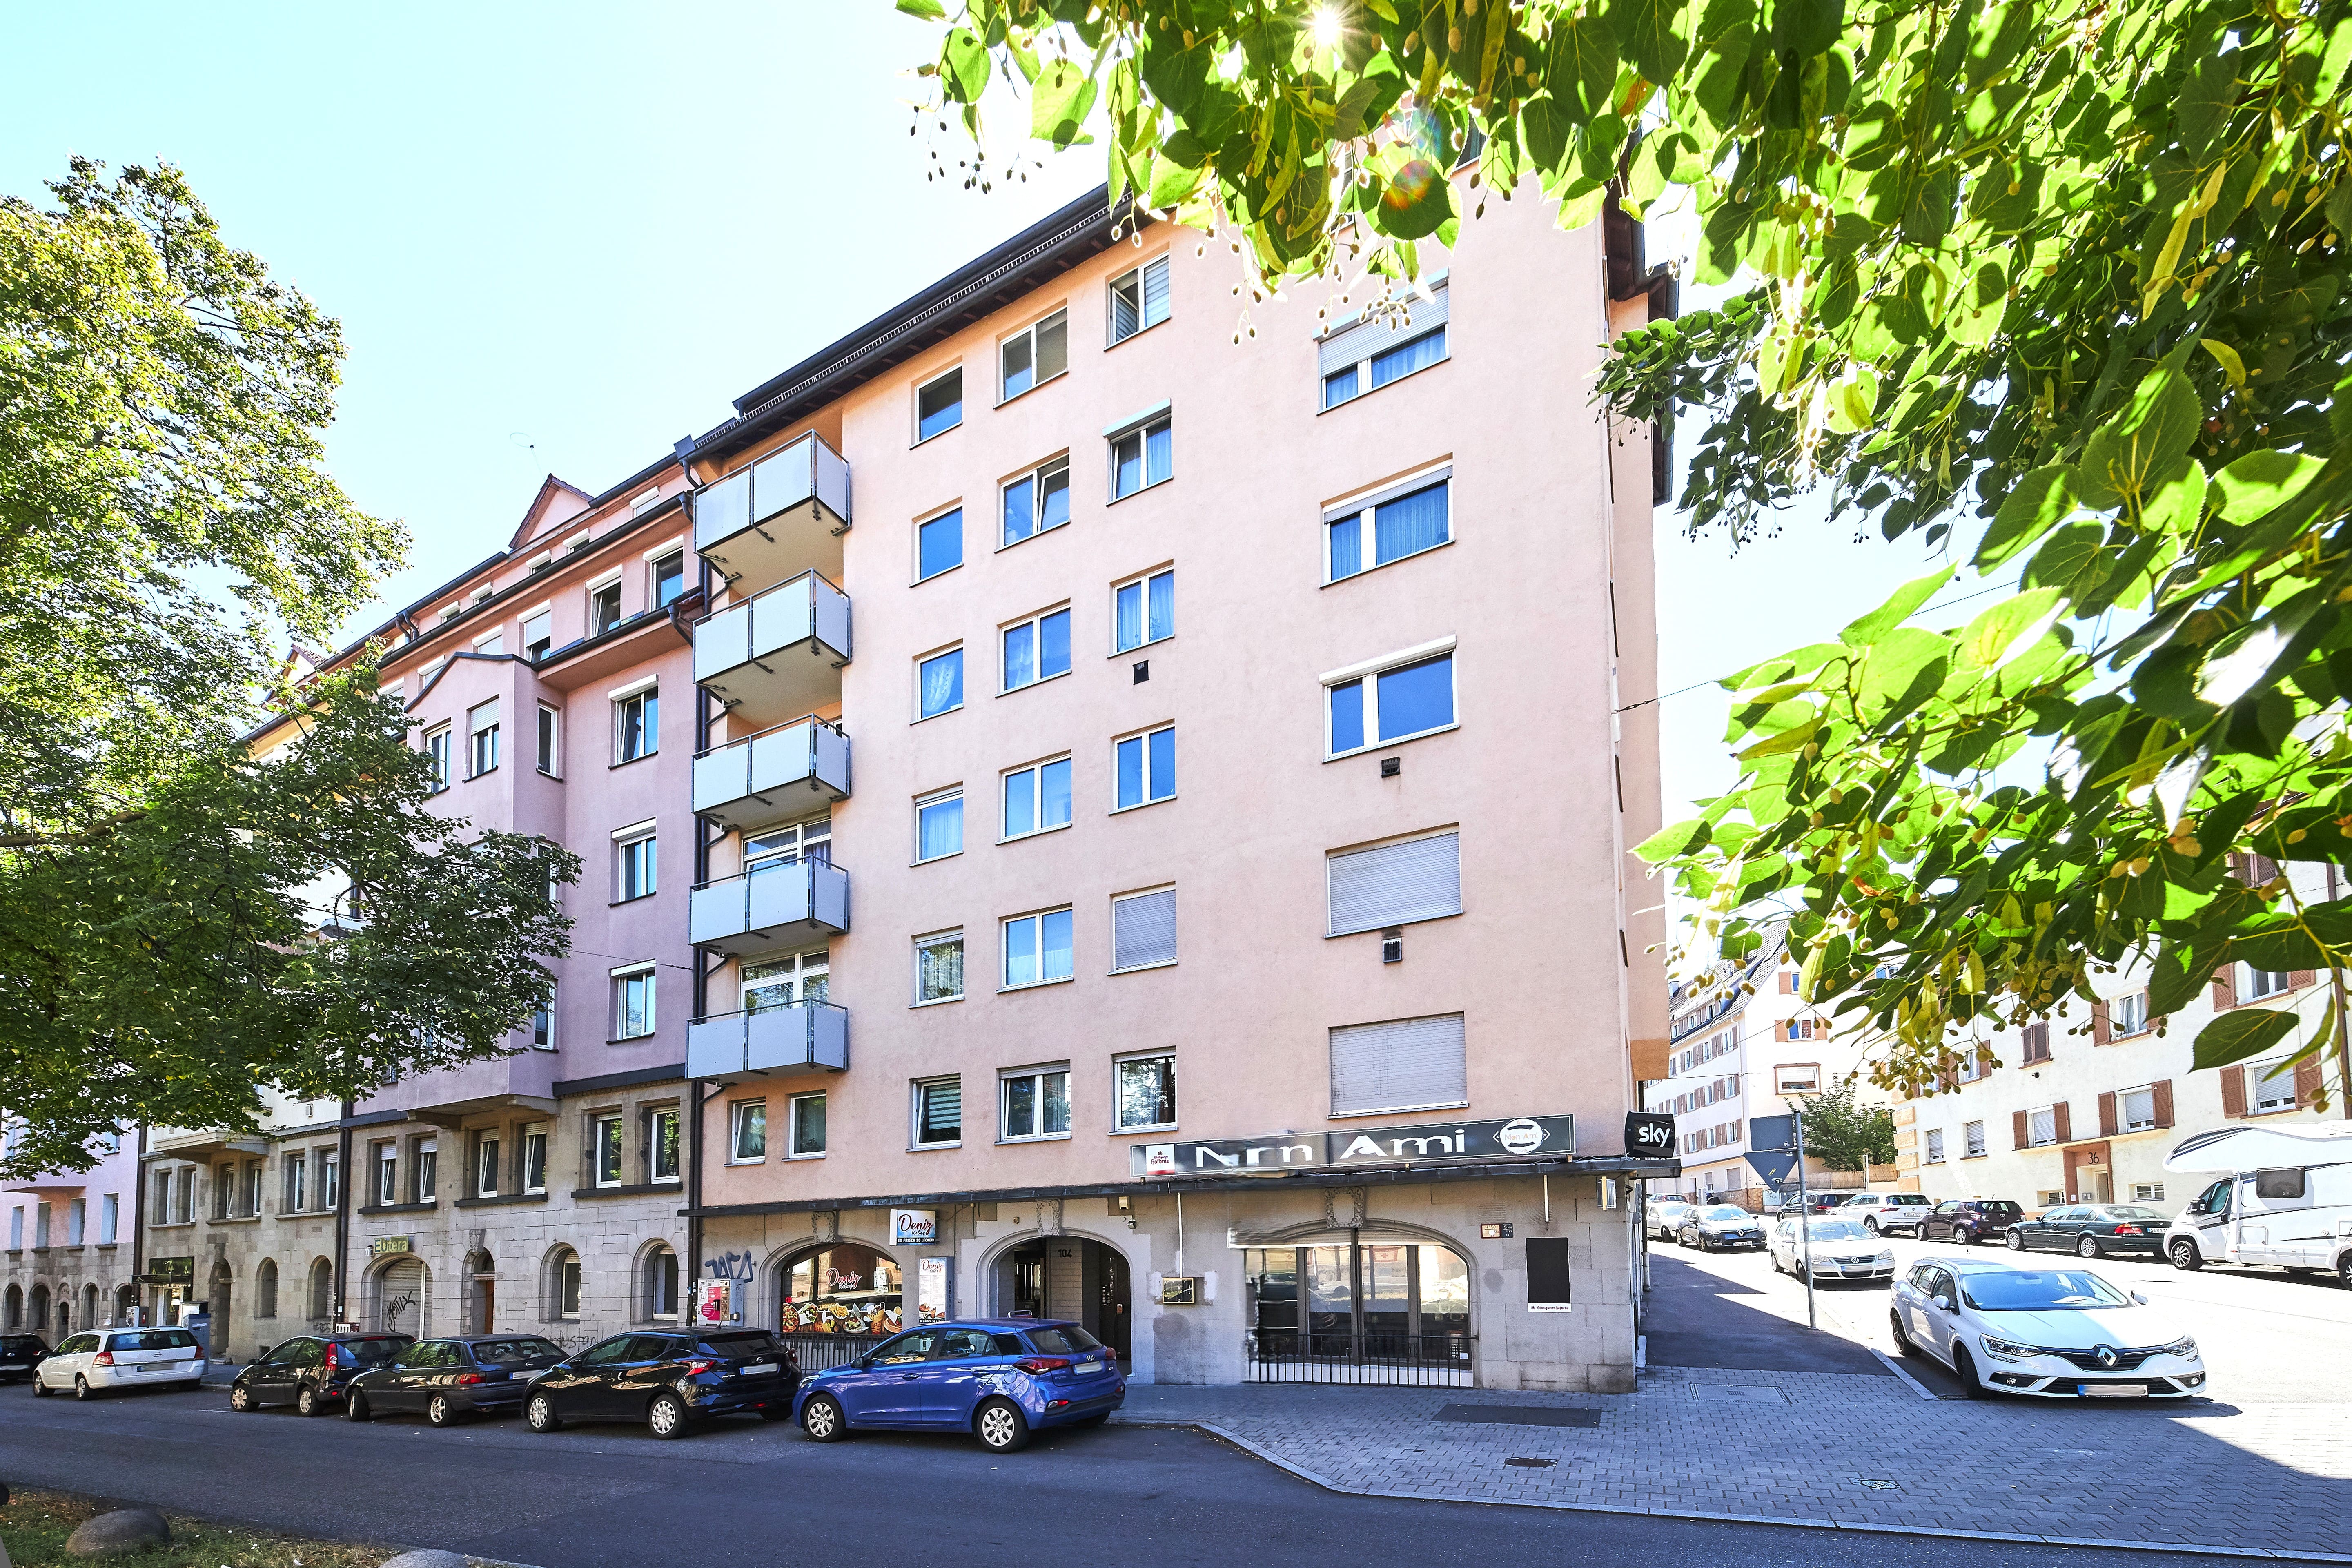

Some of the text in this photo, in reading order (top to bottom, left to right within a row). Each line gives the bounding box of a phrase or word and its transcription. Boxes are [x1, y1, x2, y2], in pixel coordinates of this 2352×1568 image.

[1339, 1129, 1466, 1160] Ami
[1639, 1123, 1670, 1147] sky
[2088, 1152, 2099, 1165] 36
[898, 1214, 934, 1236] Deniz
[1058, 1249, 1072, 1258] 104
[921, 1259, 943, 1272] Deniz
[826, 1267, 862, 1289] Deniz
